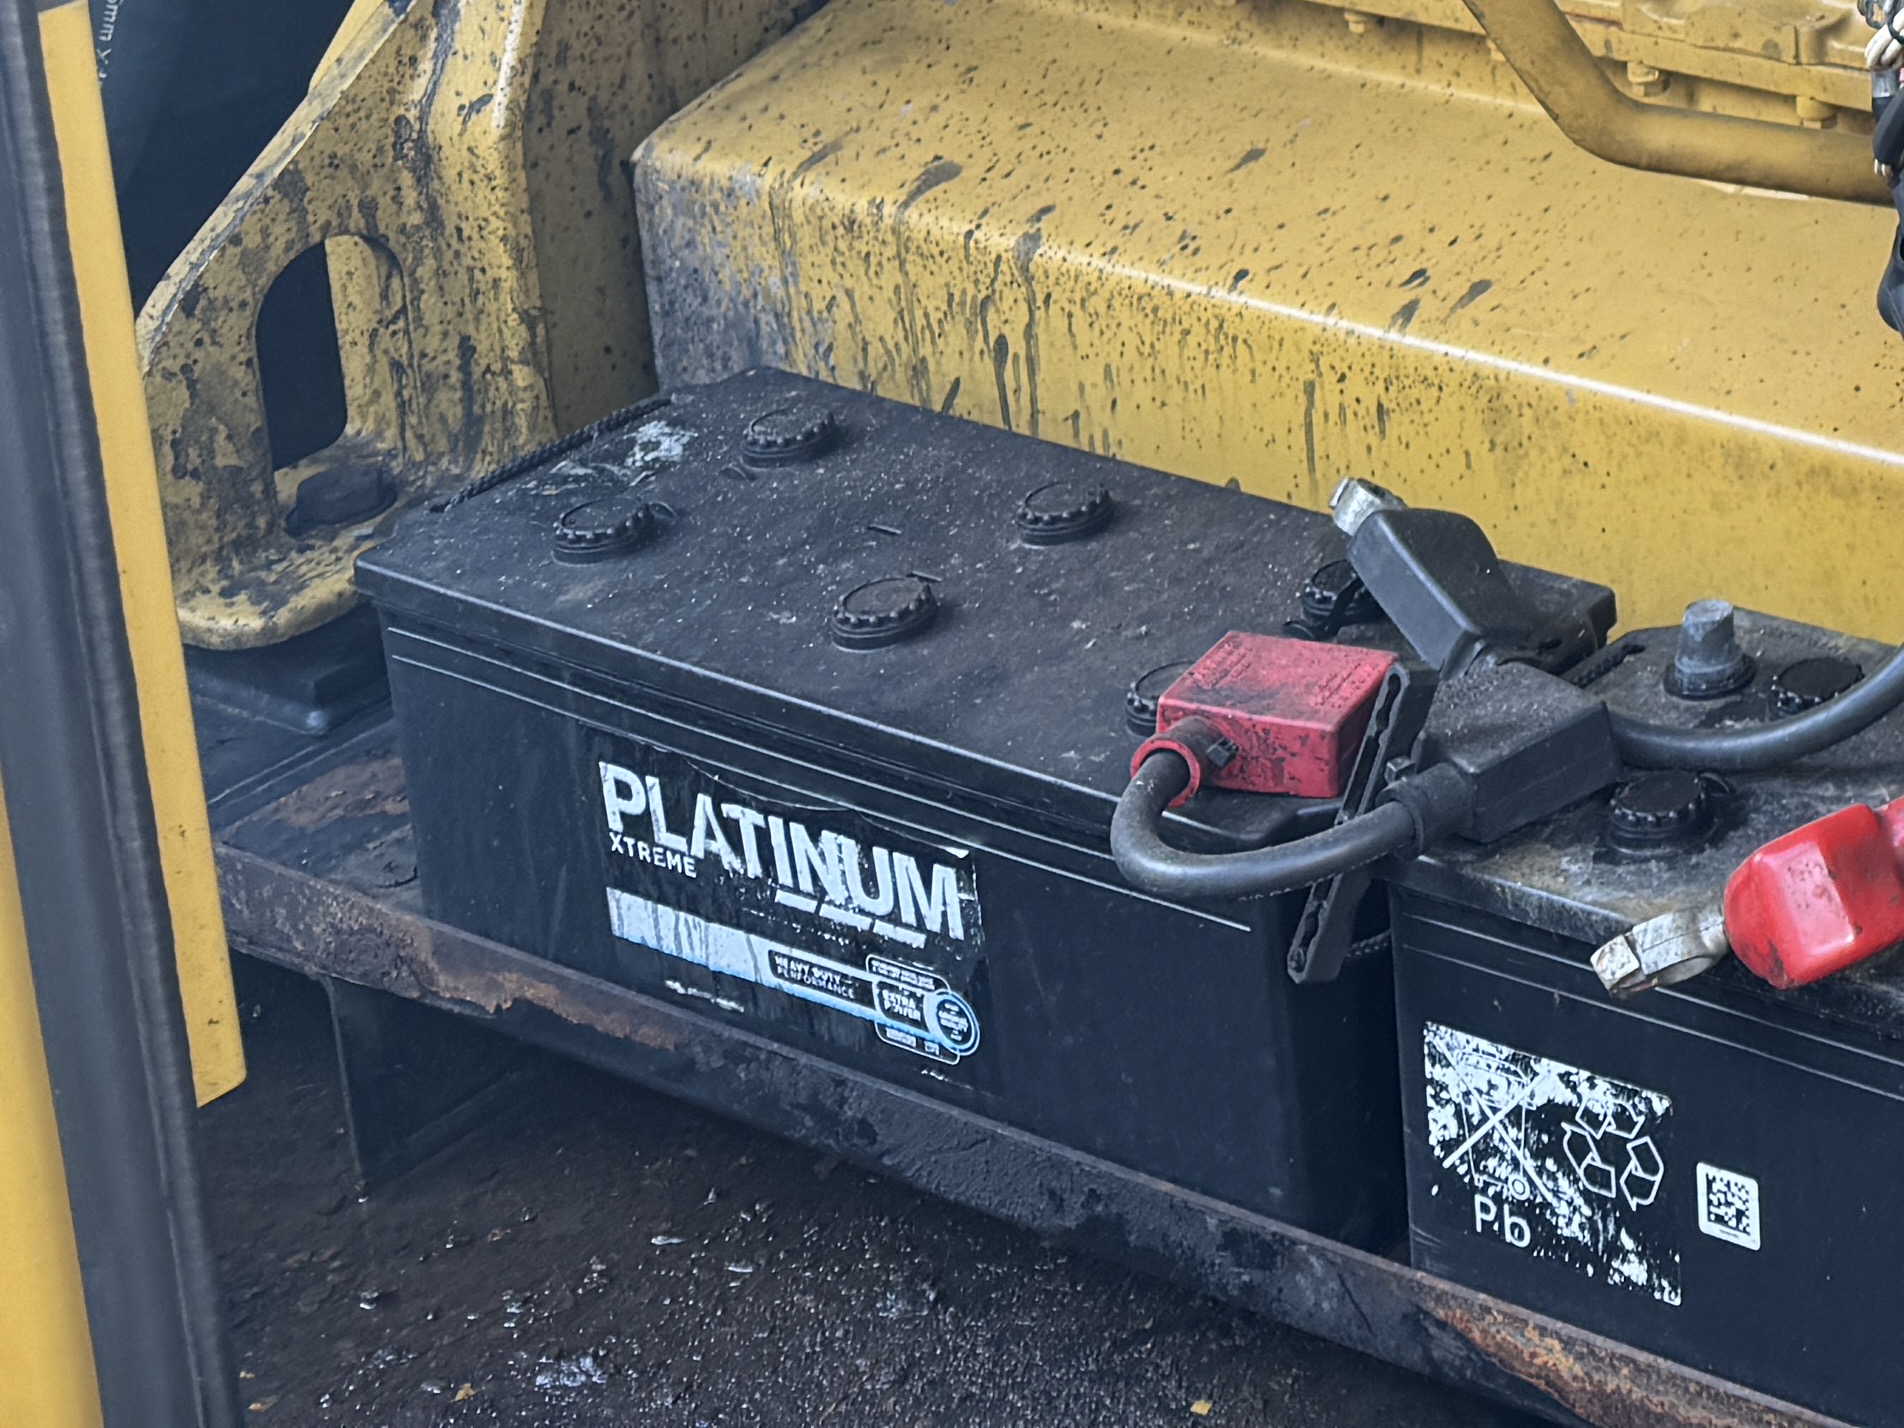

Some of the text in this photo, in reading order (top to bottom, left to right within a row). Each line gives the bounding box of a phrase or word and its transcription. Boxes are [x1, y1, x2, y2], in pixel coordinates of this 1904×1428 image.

[598, 760, 966, 942] PLATINUM
[608, 830, 698, 879] XTREME
[1473, 1194, 1532, 1249] Pb
